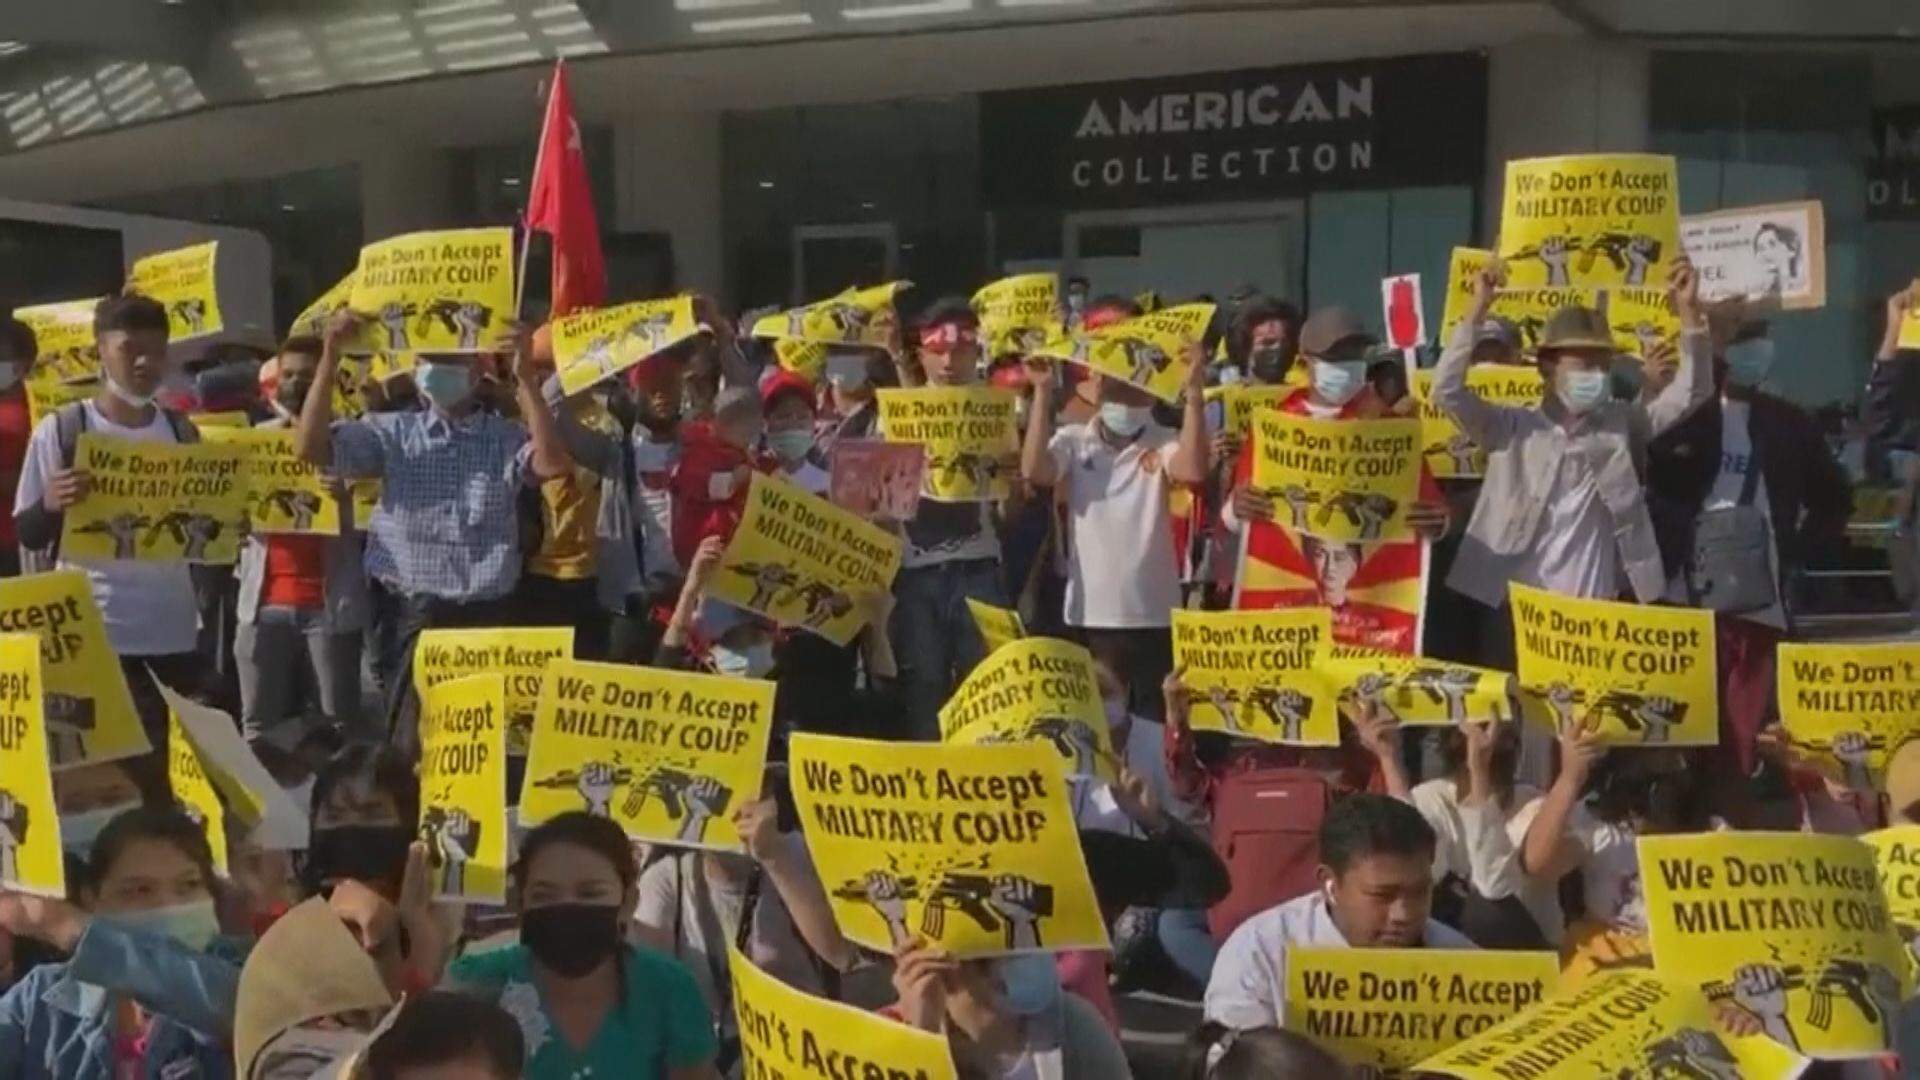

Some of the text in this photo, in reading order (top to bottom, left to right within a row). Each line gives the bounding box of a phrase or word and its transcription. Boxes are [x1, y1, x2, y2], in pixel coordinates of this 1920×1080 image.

[1075, 75, 1373, 137] AMERICAN
[1073, 141, 1372, 187] COLLECTION
[1516, 173, 1546, 193] We
[1550, 170, 1607, 191] Don't
[1515, 195, 1667, 219] MILITARY COUP
[441, 244, 503, 265] Accept
[447, 264, 499, 284] COUP
[886, 401, 908, 418] We
[912, 400, 958, 417] Don't
[1261, 421, 1288, 441] We
[1293, 428, 1345, 451] Don't
[1350, 434, 1414, 455] Accept
[89, 448, 124, 472] We
[128, 455, 180, 475] Don't
[182, 456, 240, 478] Accept
[1264, 444, 1407, 477] MILITARY COUP
[90, 475, 233, 498] MILITARY COUP
[755, 513, 835, 566] MILITARY
[761, 486, 894, 567] We Don't Accept
[1199, 625, 1247, 647] Don't
[1253, 624, 1319, 650] Accept
[1519, 601, 1700, 651] We Don't Accept
[425, 645, 450, 667] We
[454, 645, 501, 668] Don't
[1181, 648, 1316, 671] MILITARY COUP
[1524, 630, 1695, 675] MILITARY COUP
[1793, 658, 1913, 685] We Don't
[557, 676, 759, 728] We Don't Accept
[554, 707, 749, 754] MILITARY COUP
[439, 743, 488, 776] COUP
[803, 759, 1047, 809] We Don't Accept
[814, 803, 1046, 845] MILITARY COUP
[1659, 857, 1713, 892] We
[1723, 855, 1811, 888] Don't
[1673, 898, 1826, 933] MILITARY
[1303, 969, 1545, 1012] We Don't Accept
[1600, 979, 1671, 1021] COUP
[1306, 1008, 1505, 1041] MILITARY CO
